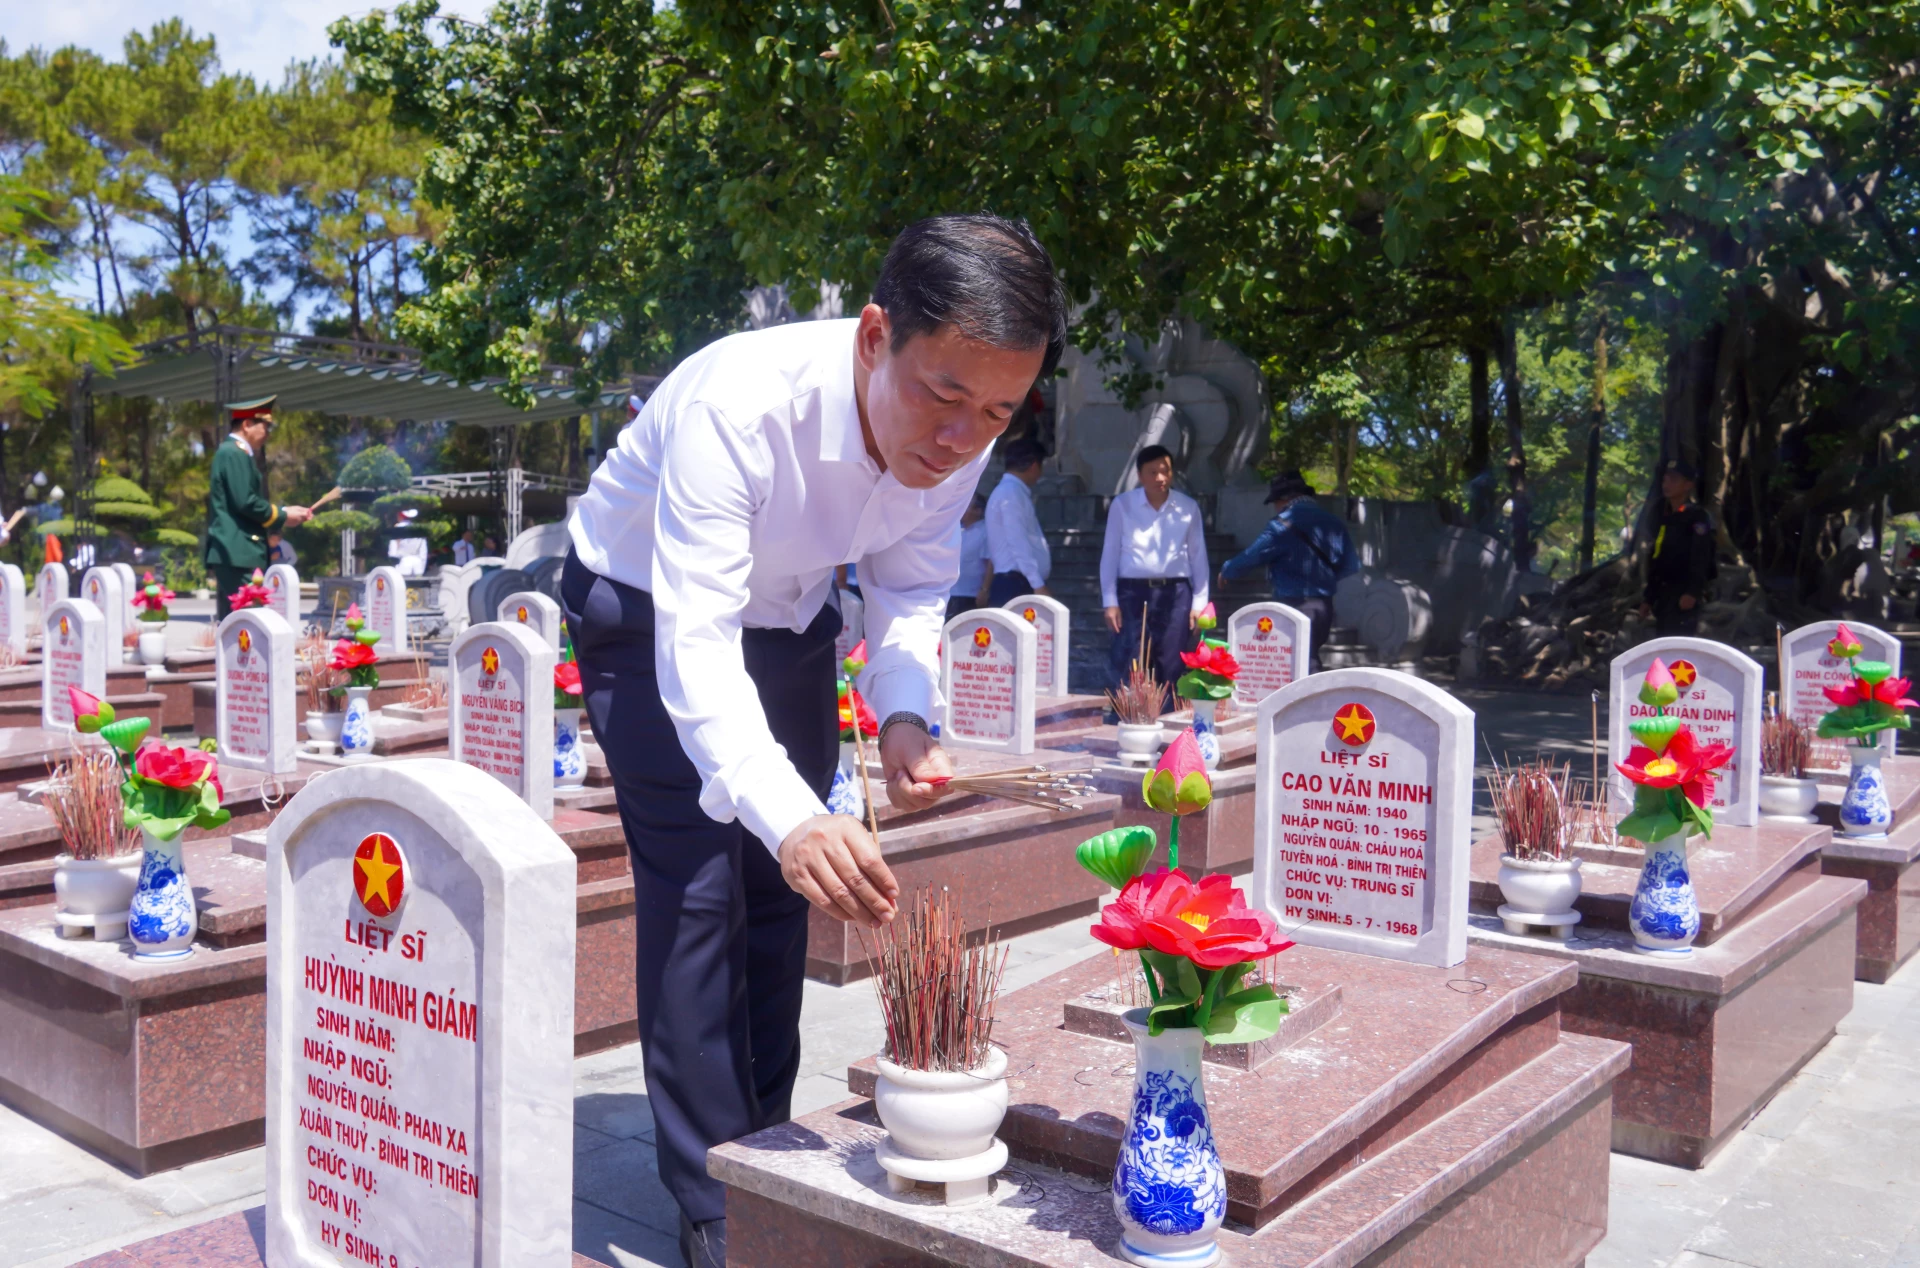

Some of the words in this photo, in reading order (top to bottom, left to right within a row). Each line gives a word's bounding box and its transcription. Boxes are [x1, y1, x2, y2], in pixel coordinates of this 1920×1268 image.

[1692, 690, 1707, 701] SĨ
[1698, 725, 1720, 733] 1947
[1707, 737, 1731, 745] 1967
[1321, 749, 1362, 769] LIỆT
[1368, 753, 1389, 769] SĨ
[1282, 772, 1323, 793] CAO
[1330, 773, 1371, 798] VĂN
[1378, 782, 1433, 804] MINH
[1303, 799, 1332, 812] SINH
[1337, 801, 1371, 816] NĂM:
[1376, 807, 1408, 820] 1940
[1282, 814, 1319, 831] NHẬP
[1324, 818, 1358, 834] NGŨ:
[1364, 824, 1380, 836] 10
[1394, 828, 1428, 842] 1965
[1284, 832, 1326, 848] NGUYÊN
[1330, 836, 1363, 853] QUÁN:
[1366, 841, 1396, 857] CHÂU
[1400, 845, 1424, 860] HOÁ
[1280, 850, 1313, 865] TUYÊN
[1316, 854, 1338, 868] HOÁ
[1347, 856, 1372, 873] BÌNH
[1376, 863, 1392, 879] TRỊ
[1395, 864, 1427, 880] THIÊN
[1286, 868, 1321, 884] CHỨC
[1325, 874, 1347, 891] VỤ:
[1351, 878, 1396, 895] TRUNG
[1401, 883, 1415, 897] SĨ
[1286, 887, 1313, 902] ĐƠN
[1317, 892, 1333, 907] VỊ:
[1286, 905, 1303, 917] HY
[1307, 908, 1341, 924] SINH:
[1345, 915, 1353, 926] 5
[1365, 918, 1373, 929] 7
[1387, 920, 1417, 936] 1968
[346, 919, 394, 956] LIỆT
[401, 930, 427, 963] SĨ
[305, 954, 364, 1006] HUỲNH
[370, 975, 417, 1024] MINH
[423, 988, 477, 1043] GIÁM
[317, 1007, 350, 1038] SINH
[355, 1017, 395, 1053] NĂM:
[304, 1037, 346, 1075] NHẬP
[352, 1055, 392, 1090] NGŨ:
[308, 1074, 357, 1113] NGUYÊN
[361, 1095, 400, 1130] QUÁN:
[405, 1112, 442, 1147] PHAN
[447, 1127, 467, 1156] XA
[300, 1106, 332, 1139] XUÂN
[335, 1121, 368, 1153] THUỶ
[379, 1135, 409, 1172] BÌNH
[413, 1152, 433, 1188] TRỊ
[437, 1161, 479, 1199] THIÊN
[308, 1145, 347, 1180] CHỨC
[352, 1163, 377, 1198] VỤ:
[308, 1179, 338, 1213] ĐƠN
[343, 1195, 361, 1228] VỊ:
[322, 1220, 340, 1248] HY
[345, 1233, 384, 1268] SINH:
